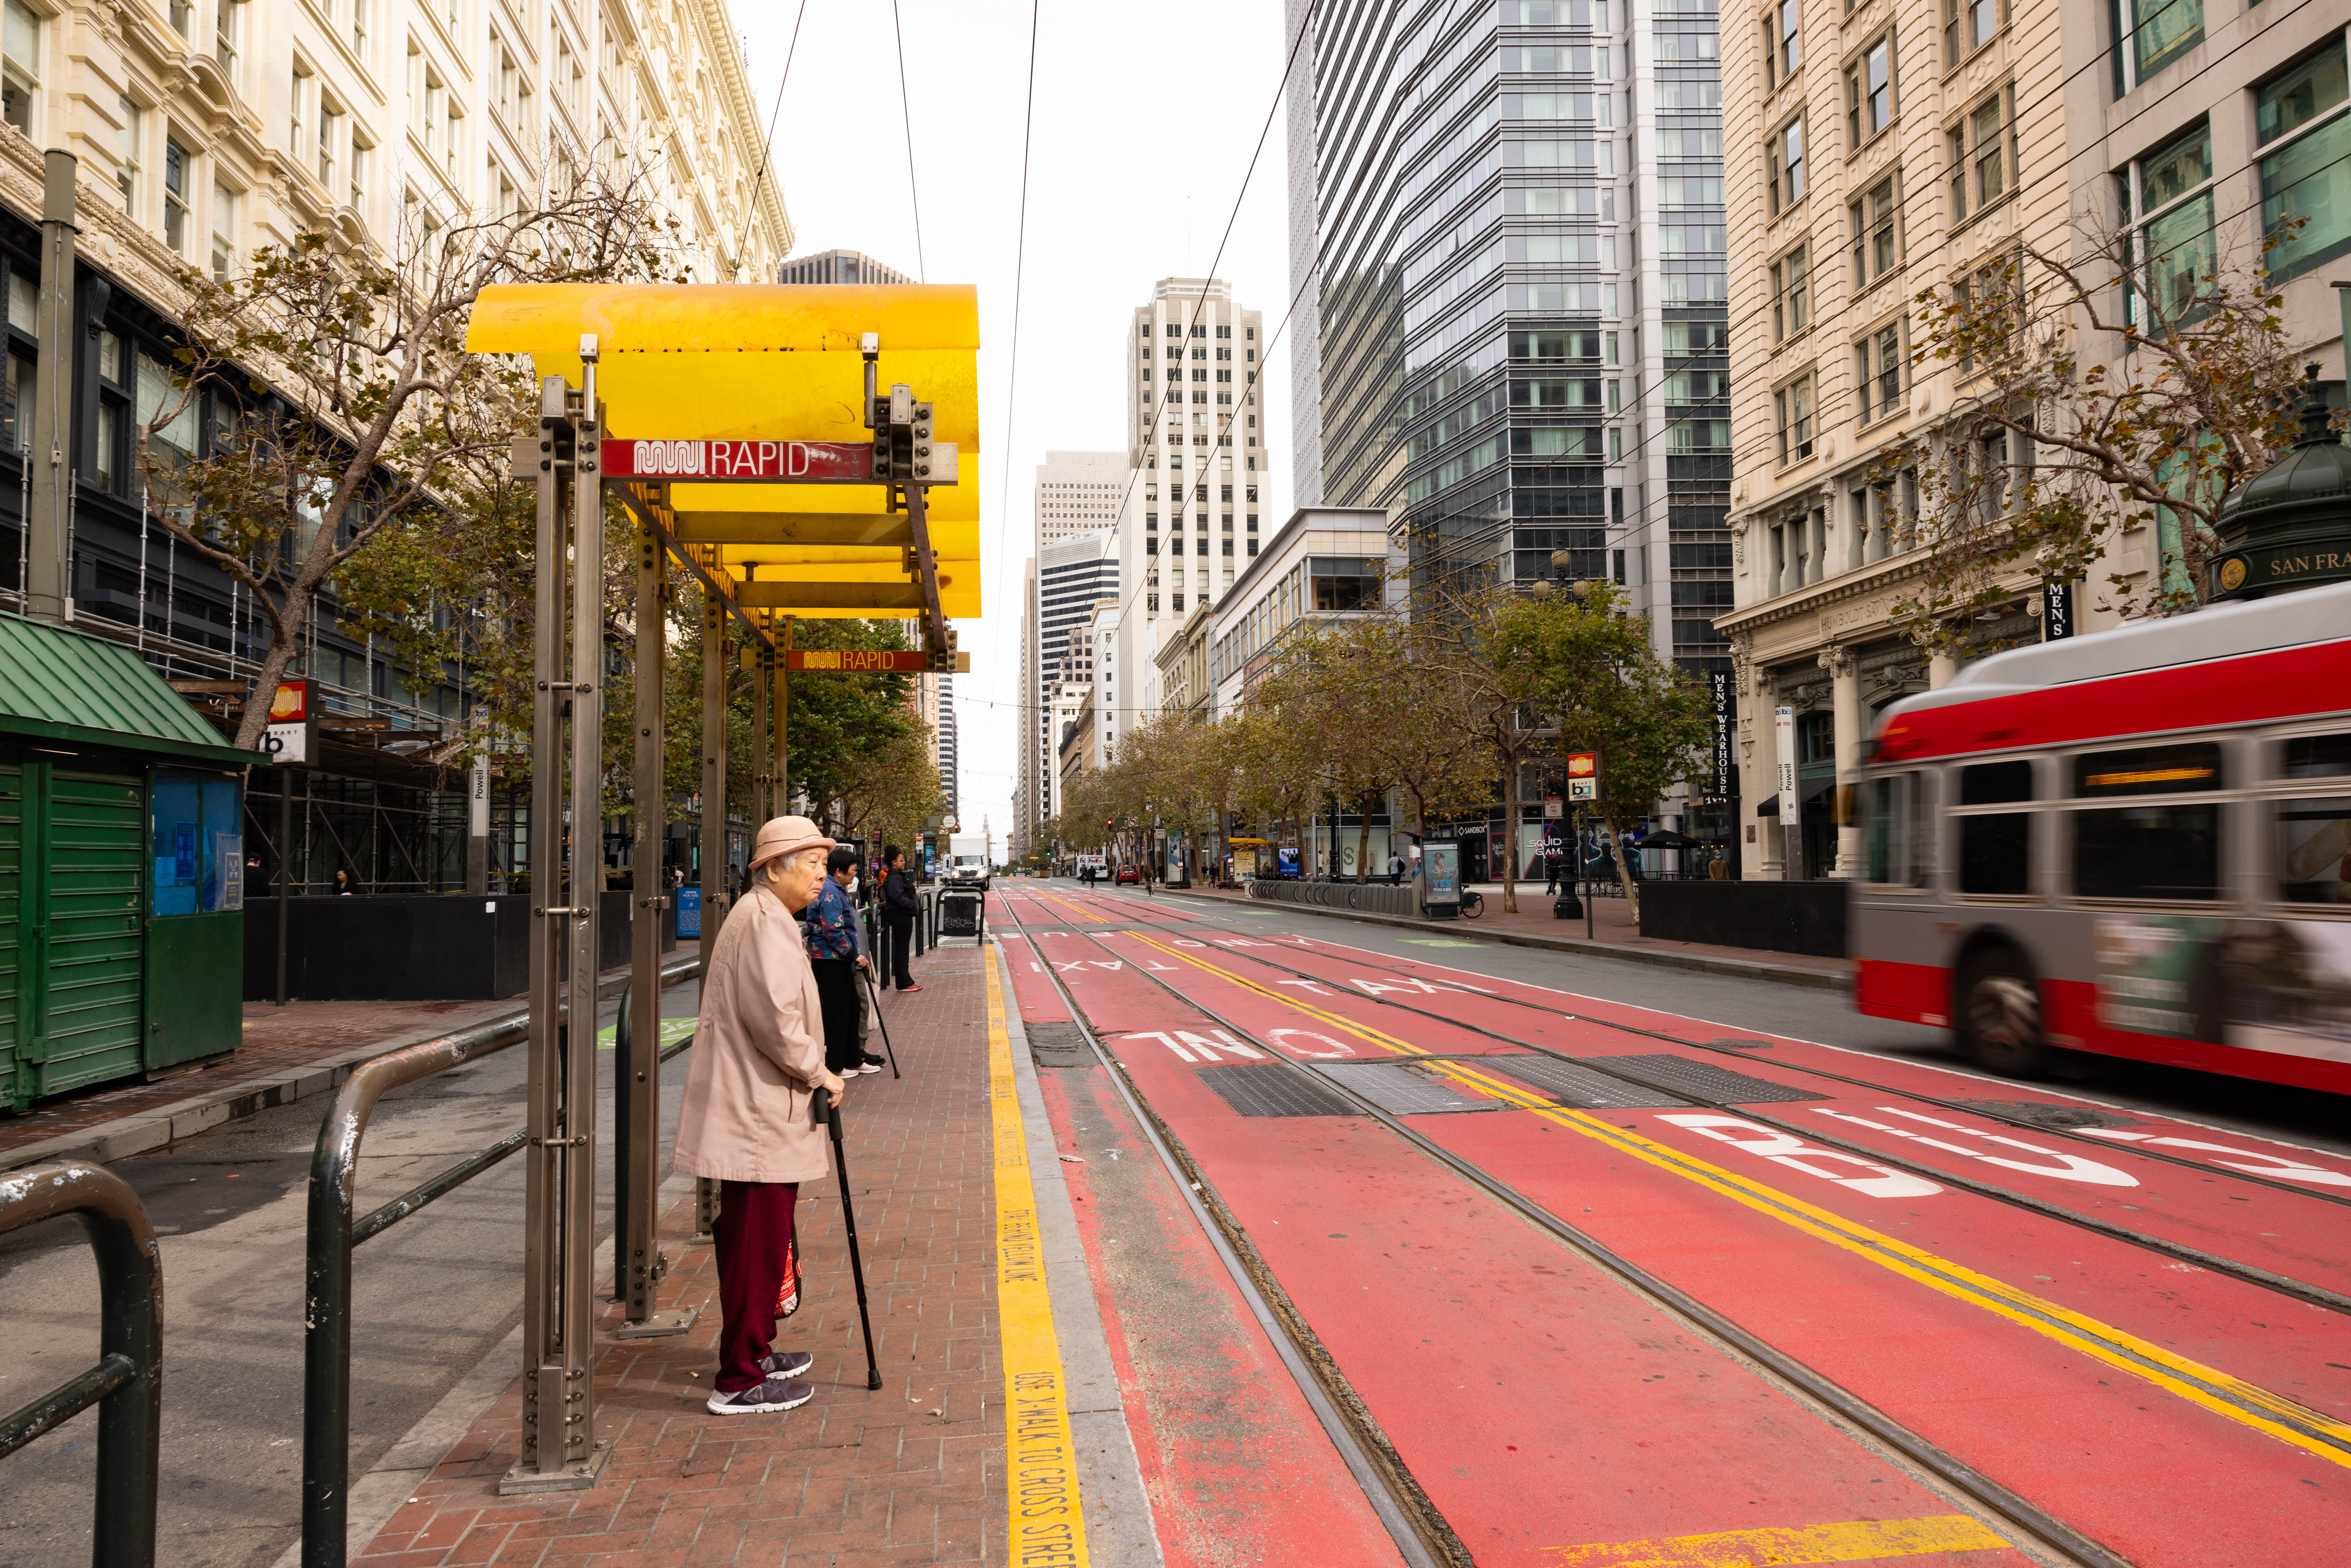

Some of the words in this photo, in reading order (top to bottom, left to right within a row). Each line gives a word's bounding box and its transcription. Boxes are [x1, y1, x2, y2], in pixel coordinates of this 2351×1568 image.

[711, 441, 809, 475] RAPID
[2271, 556, 2310, 575] SAN
[2049, 583, 2066, 635] MEN'S
[844, 651, 894, 670] RAPID
[1715, 674, 1727, 711] MEN'S
[1716, 715, 1728, 794] WEARHOUSE
[1526, 835, 1562, 848] SQUID
[1433, 879, 1452, 888] YES
[1030, 960, 1178, 972] TAXI
[1276, 978, 1500, 997] TAXI
[1003, 1209, 1031, 1221] STAY
[1002, 1242, 1035, 1266] YELLOW
[1004, 1268, 1038, 1283] LINE
[1014, 1371, 1055, 1392] USE
[1016, 1396, 1060, 1442] X-WALK
[1018, 1446, 1063, 1463] TO
[1019, 1467, 1069, 1517] CROSS
